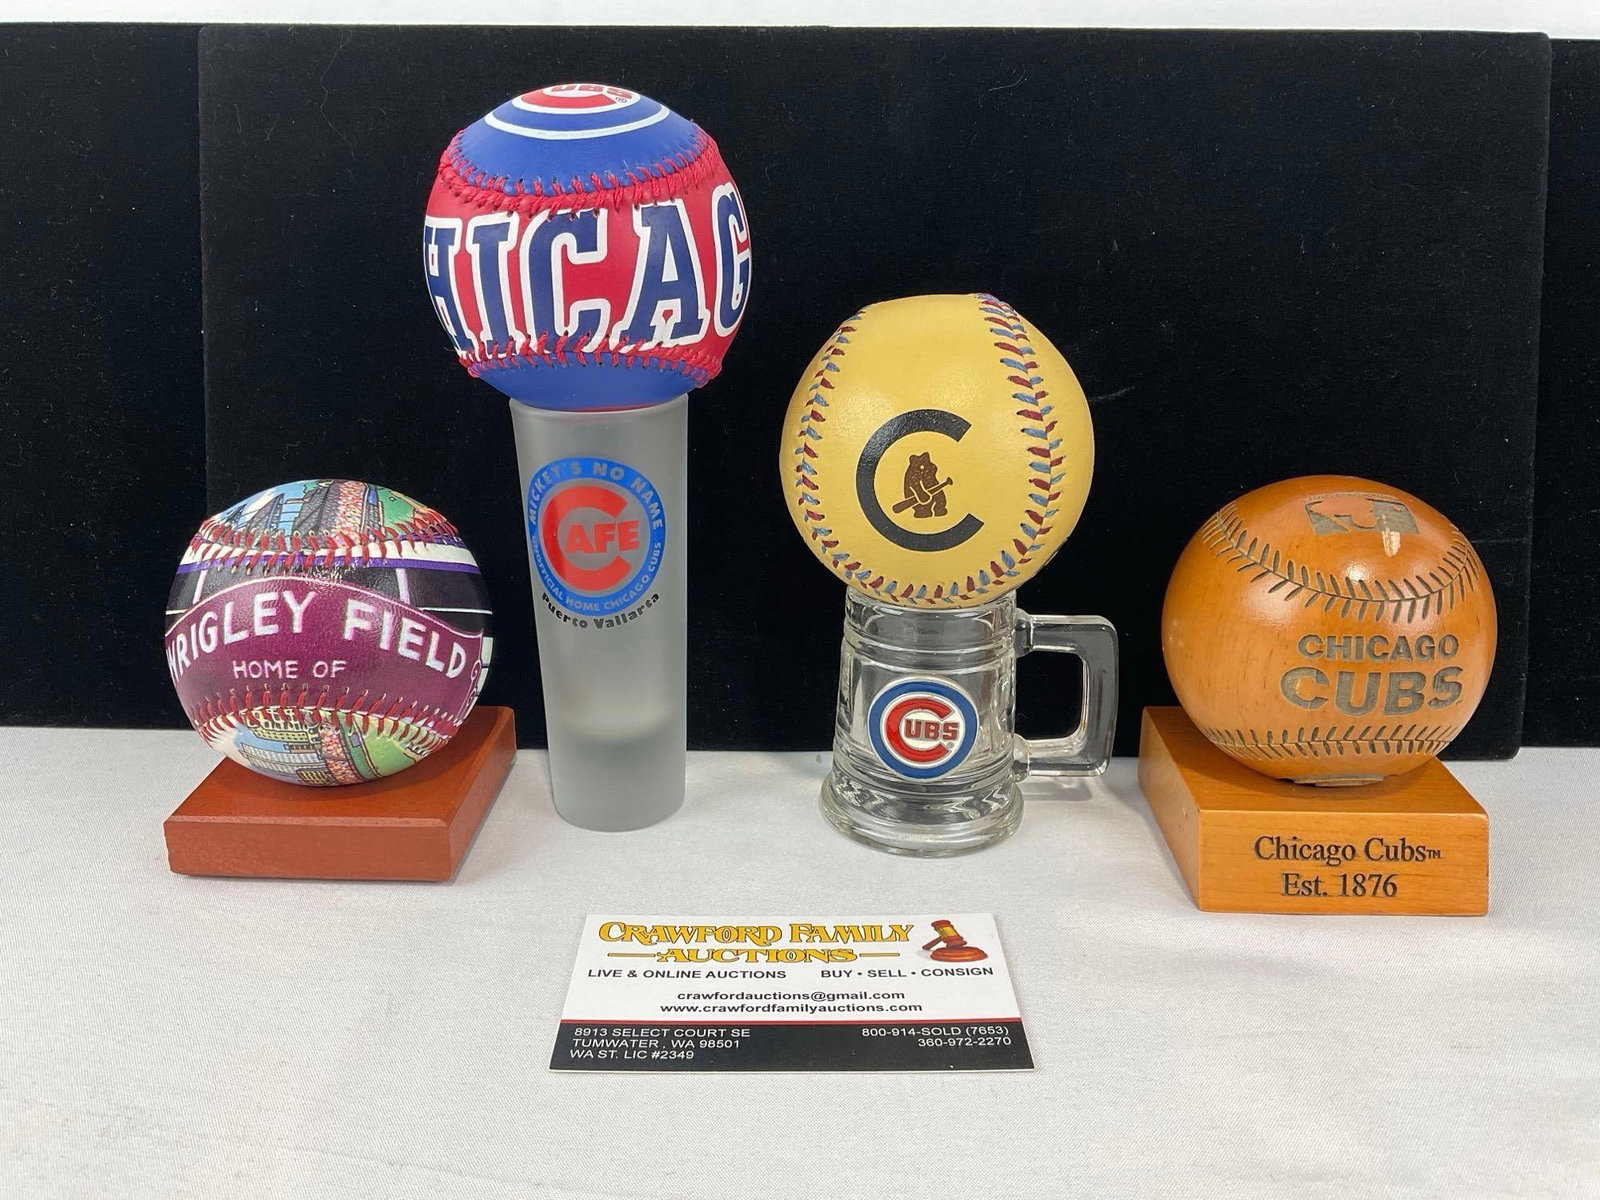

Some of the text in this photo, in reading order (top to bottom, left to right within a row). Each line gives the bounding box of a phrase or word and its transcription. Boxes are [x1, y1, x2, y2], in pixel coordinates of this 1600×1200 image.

[529, 461, 663, 530] MICKEY'S NO NAME
[541, 485, 641, 592] CAFE
[565, 597, 600, 612] HOME
[603, 574, 650, 611] CHICAGO
[648, 542, 662, 572] CUBS
[541, 592, 660, 630] Puerto Vallarta
[165, 590, 467, 687] WRIGLEY FIELD
[1297, 634, 1460, 662] CHICAGO
[233, 661, 349, 679] HOME OF
[1280, 666, 1464, 717] CUBS
[1254, 835, 1356, 867] Chicago
[1281, 872, 1398, 897] Est. 1876
[598, 921, 914, 946] CRAWFORD FAMILY
[656, 948, 858, 964] AUCTIONS
[587, 969, 787, 979] LIVE & ONLINE AUCTIONS
[820, 967, 994, 978] BUY SELL CONSIGN
[677, 991, 905, 1001] crawfordauctions@gmail.com
[660, 1003, 922, 1014] www.crawfordfamilyauctions.com
[574, 1027, 751, 1038] 8913 SELECT COURT SE
[861, 1025, 1009, 1037] 800-914-SOLD (7653)
[671, 1039, 695, 1049] WA
[699, 1039, 740, 1049] 98501
[917, 1036, 1012, 1047] 360-972-2270
[570, 1049, 695, 1060] WA ST. LIC #2349
